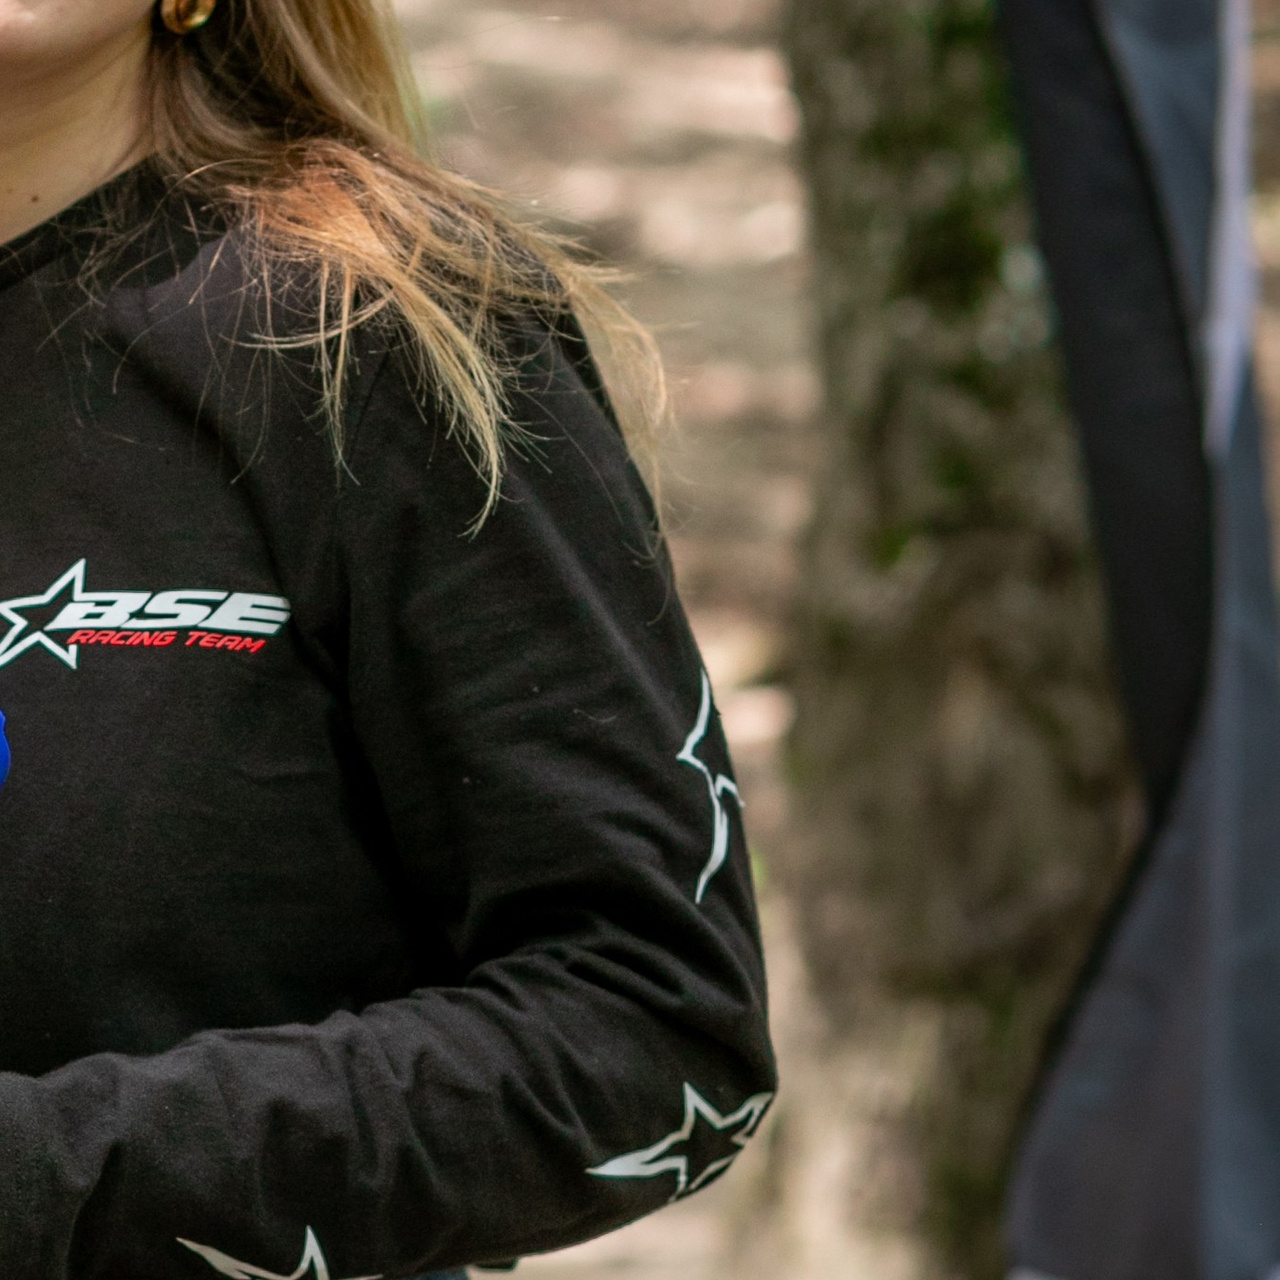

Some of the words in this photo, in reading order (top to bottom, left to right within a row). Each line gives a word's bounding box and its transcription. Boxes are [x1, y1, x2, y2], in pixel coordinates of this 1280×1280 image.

[44, 589, 292, 634] BSE
[68, 629, 177, 647] RACING
[185, 631, 266, 653] TEAM
